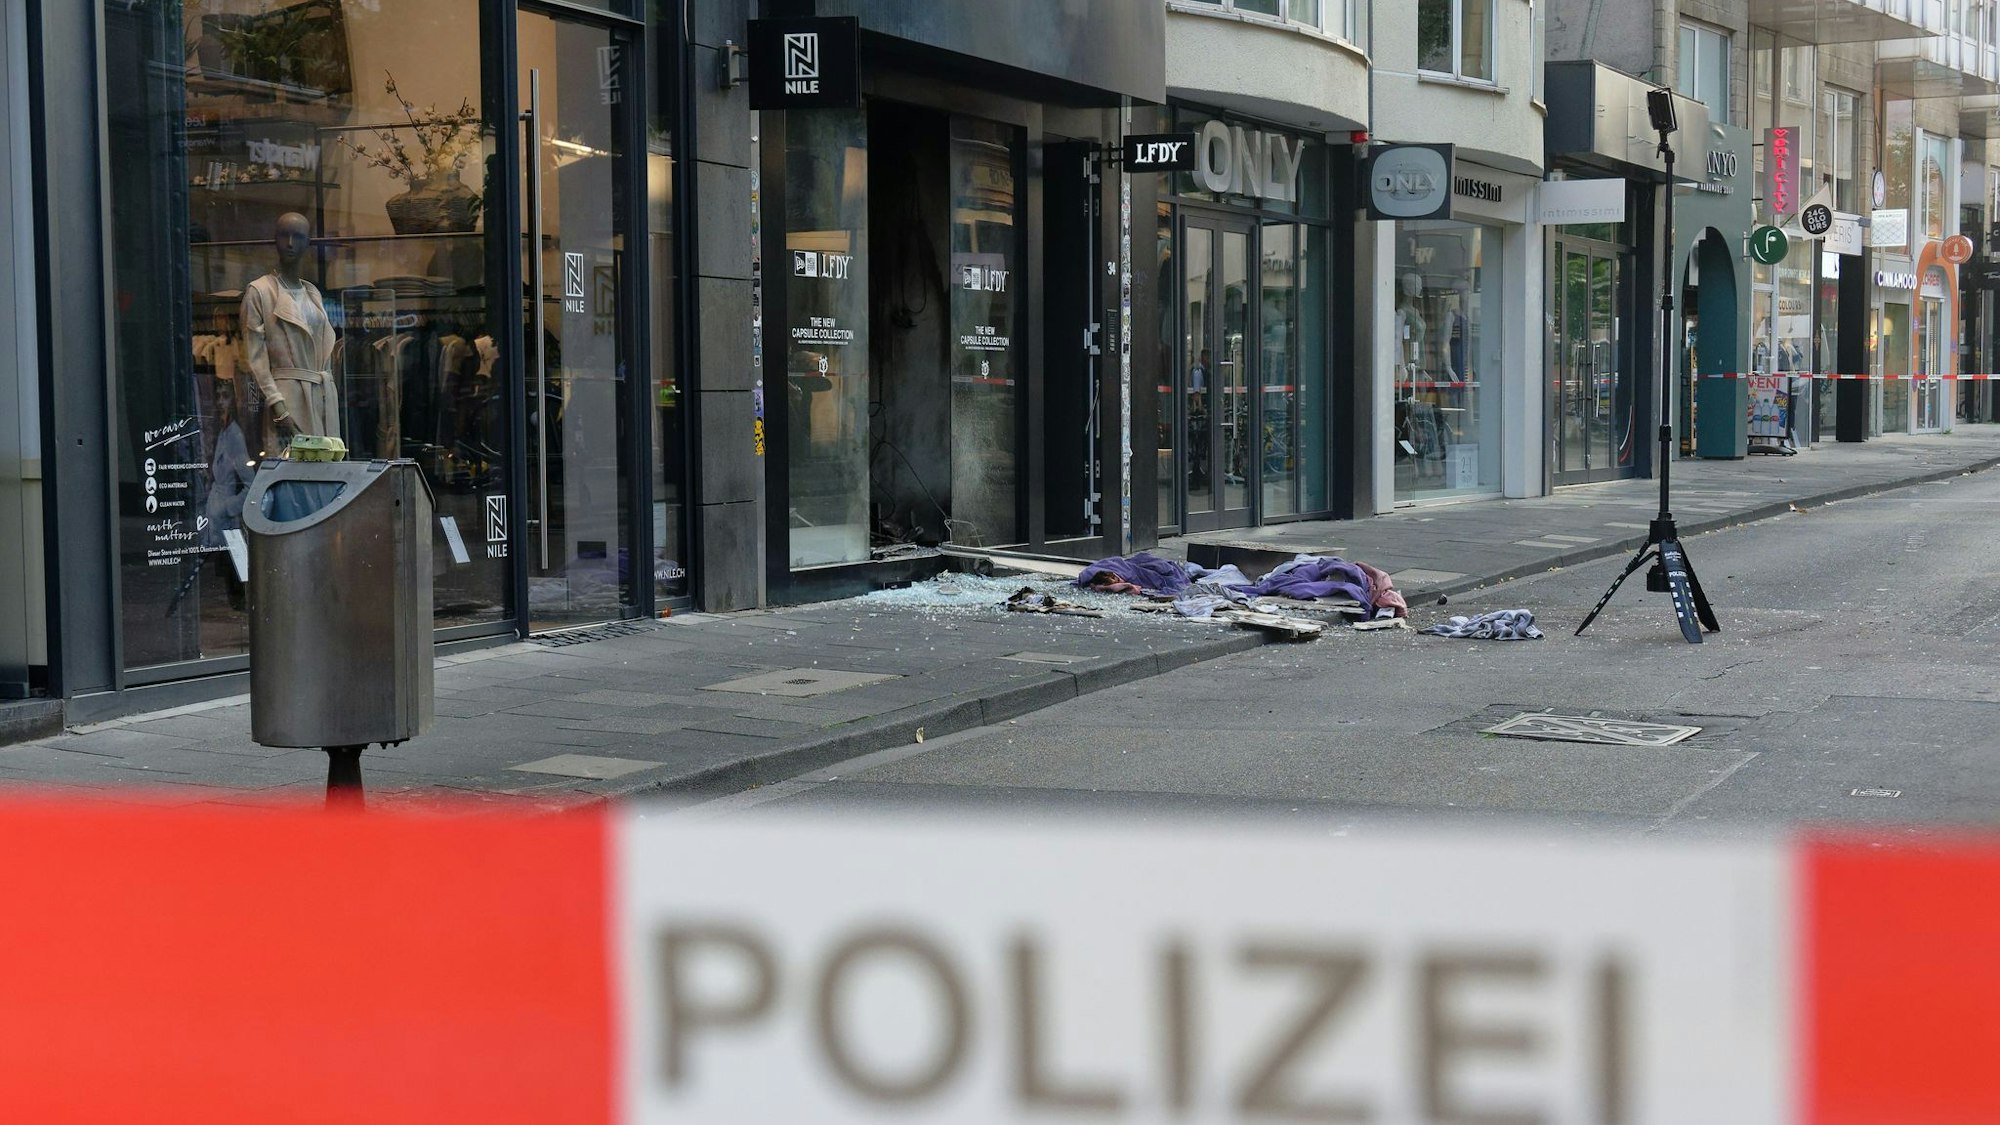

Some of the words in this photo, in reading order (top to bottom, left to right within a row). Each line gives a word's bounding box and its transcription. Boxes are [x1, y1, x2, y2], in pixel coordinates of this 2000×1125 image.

[785, 80, 819, 94] NILE
[1196, 119, 1304, 203] ONLY
[1375, 168, 1441, 194] ONLY
[1807, 207, 1825, 218] 24C
[1808, 214, 1826, 225] OLO
[1809, 221, 1827, 232] URS
[1107, 261, 1116, 275] 34
[1877, 270, 1918, 290] CINNAMOOD
[565, 300, 585, 313] NILE
[810, 317, 822, 327] THE
[823, 317, 836, 328] NEW
[792, 328, 819, 339] CAPSULE
[819, 328, 854, 340] COLLECTION
[975, 326, 984, 335] THE
[984, 326, 995, 336] NEW
[960, 335, 982, 346] CAPSULE
[982, 336, 1010, 347] COLLECTION
[159, 482, 168, 490] ECO
[146, 518, 182, 532] earth
[155, 529, 198, 541] matters
[161, 548, 172, 556] Store
[487, 543, 508, 559] NILE
[648, 915, 1640, 1125] POLIZEI
